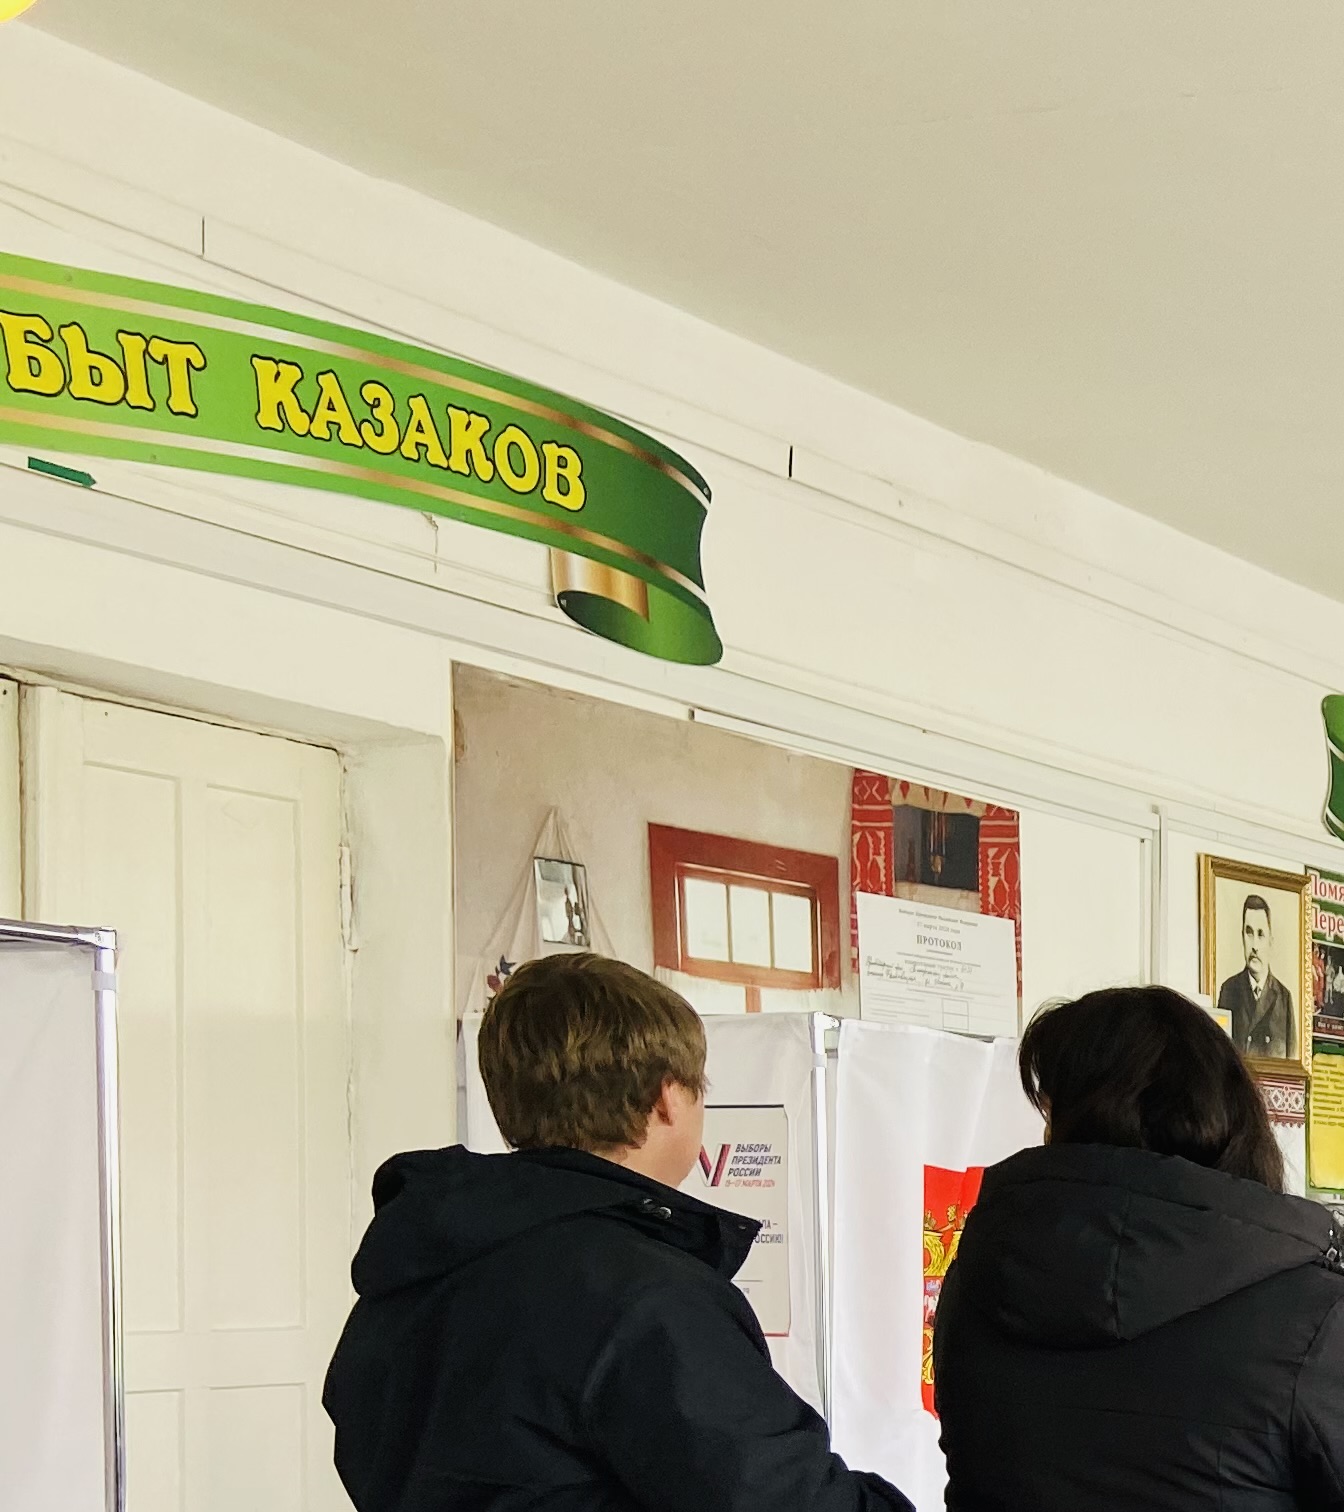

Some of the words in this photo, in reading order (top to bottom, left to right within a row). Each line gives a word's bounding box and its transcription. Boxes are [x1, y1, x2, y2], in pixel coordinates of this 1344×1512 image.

[0, 309, 205, 417] БЫТ
[251, 354, 588, 512] КАЗАКОВ
[917, 934, 962, 951] ПРОТОКОЛ
[735, 1143, 772, 1153] ВЫБОРЫ
[731, 1156, 782, 1166] ПРЕЗИДЕНТА
[728, 1167, 762, 1177] РОССИИ
